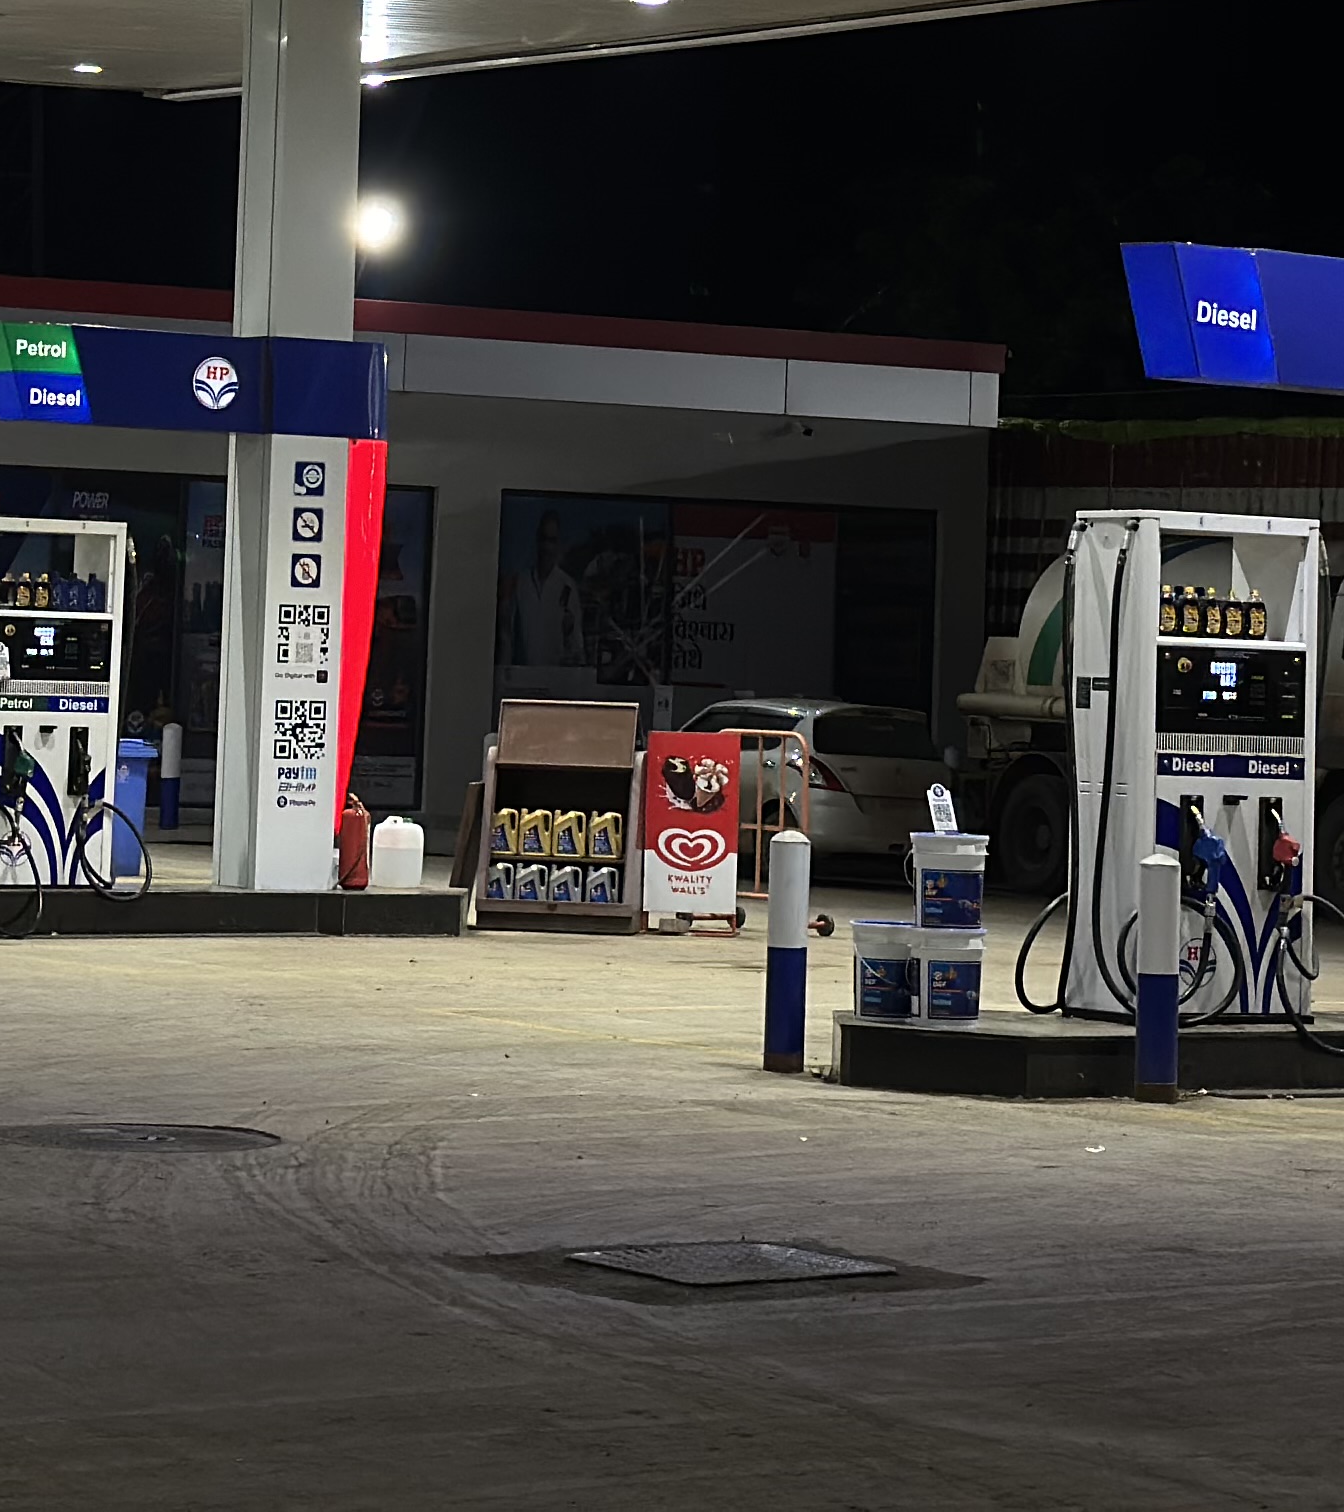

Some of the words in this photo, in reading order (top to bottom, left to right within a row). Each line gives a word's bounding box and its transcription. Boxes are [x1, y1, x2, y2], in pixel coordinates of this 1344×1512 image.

[1196, 300, 1257, 331] Diesel
[16, 339, 67, 358] Petrol
[206, 366, 230, 381] HP
[29, 388, 81, 407] Diesel
[72, 491, 110, 509] POWER
[0, 697, 33, 709] Petrol
[59, 699, 98, 710] Diesel
[1172, 757, 1214, 772] Diesel
[1248, 760, 1290, 775] Diesel
[667, 874, 713, 884] KWALITY
